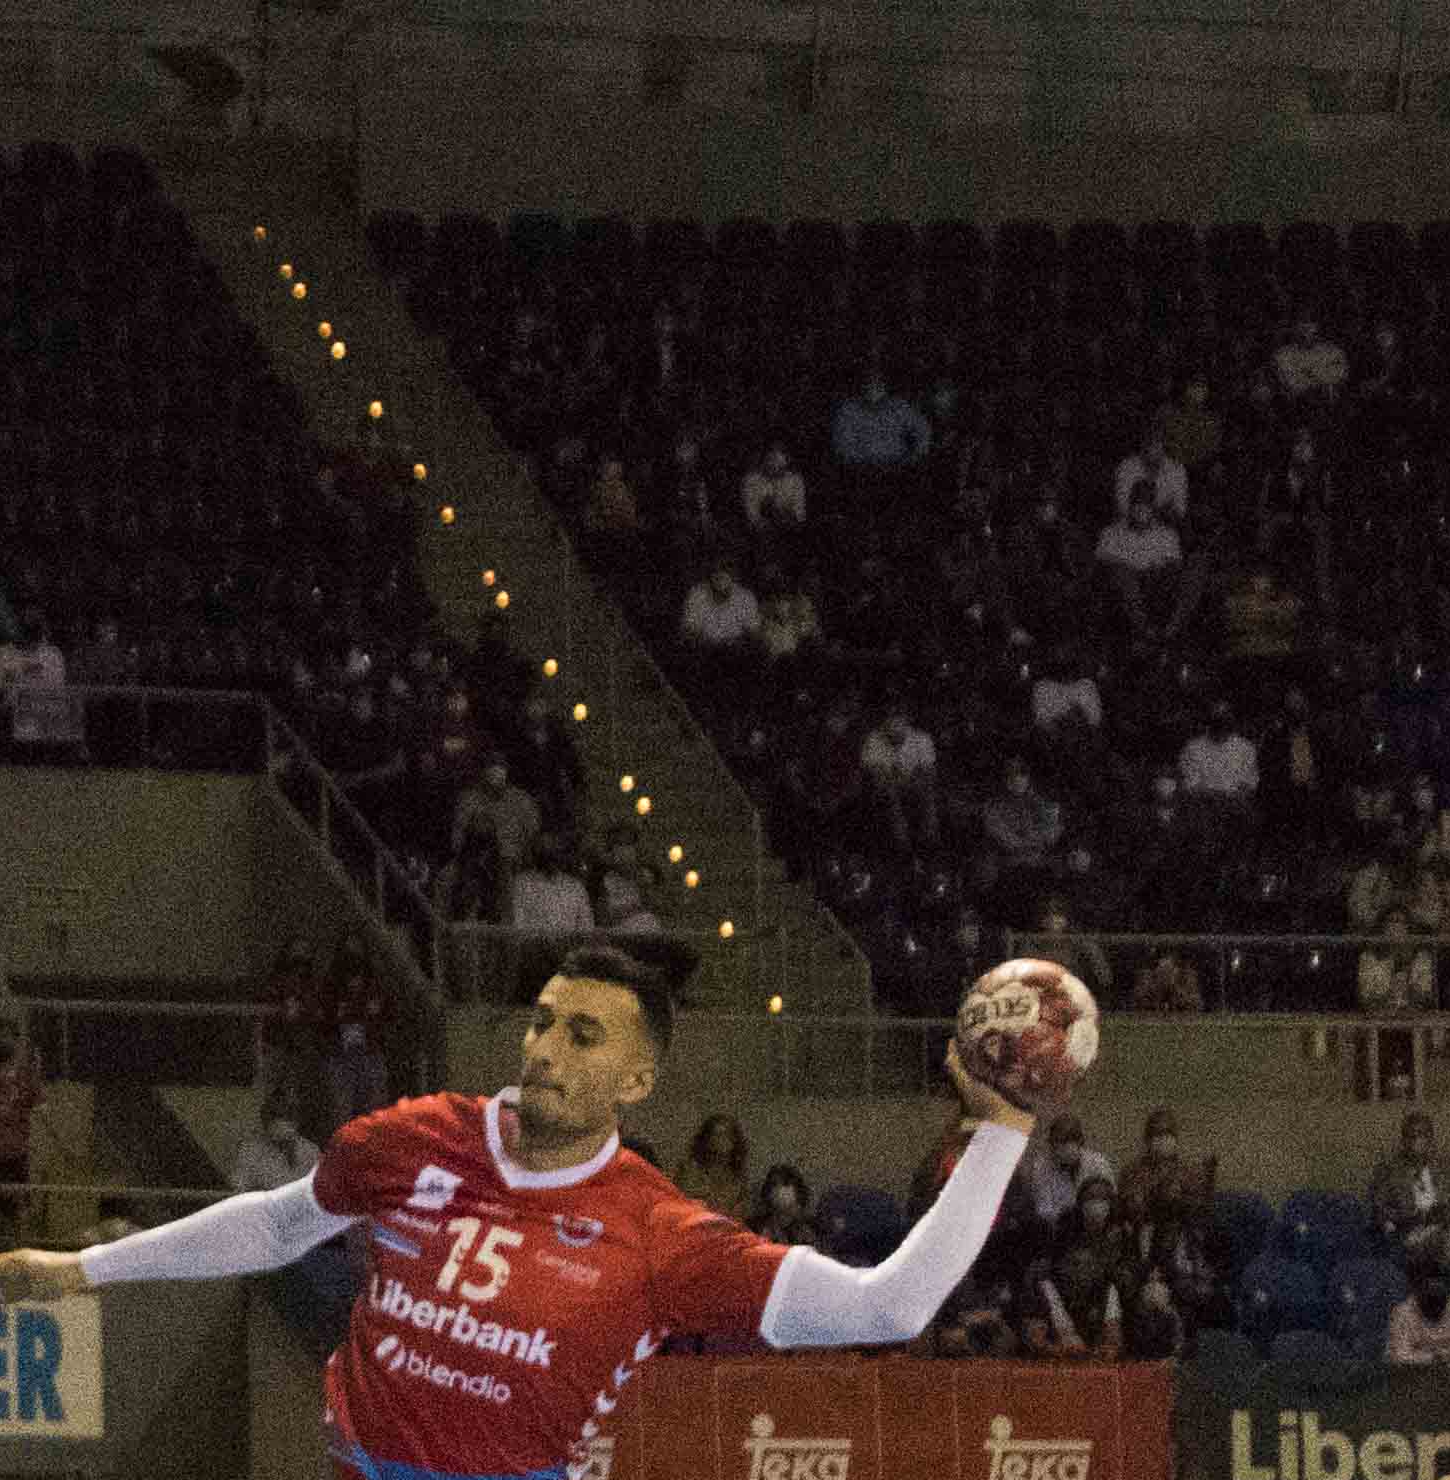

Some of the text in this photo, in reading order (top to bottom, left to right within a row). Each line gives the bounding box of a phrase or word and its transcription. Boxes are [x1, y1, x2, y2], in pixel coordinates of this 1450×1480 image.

[435, 1216, 524, 1301] 15
[369, 1273, 558, 1368] Liberbank
[404, 1350, 512, 1405] blendio
